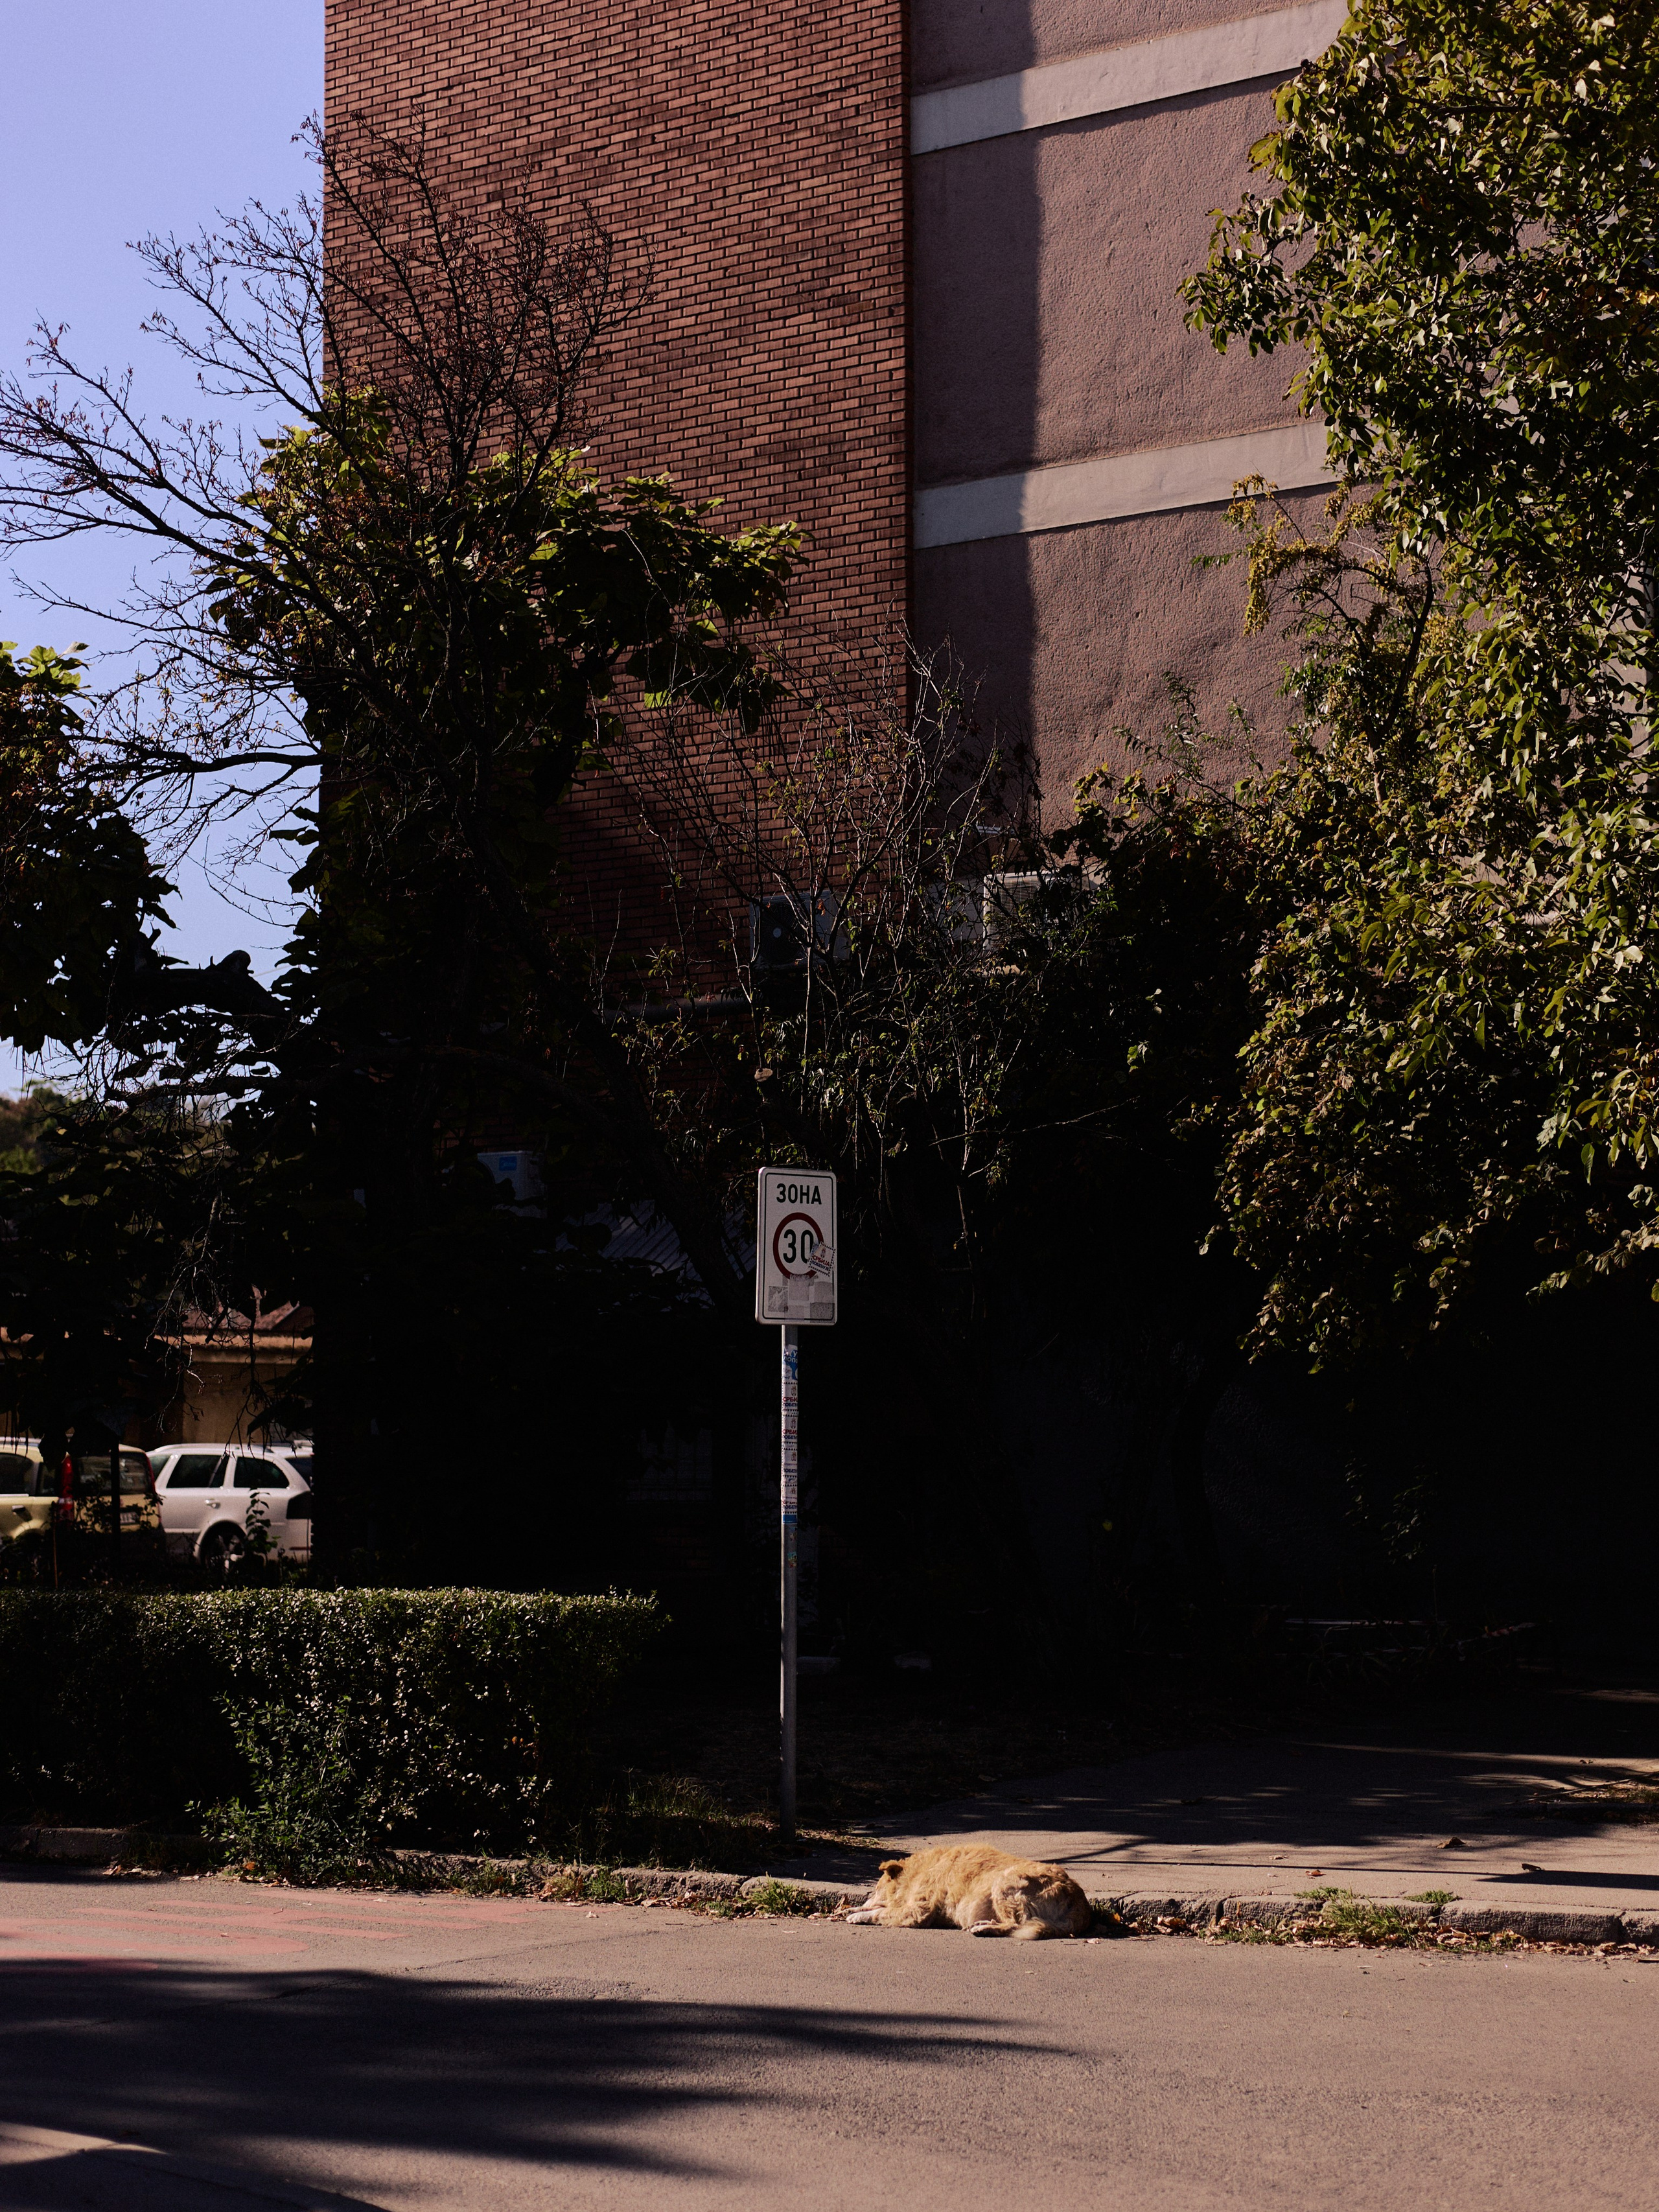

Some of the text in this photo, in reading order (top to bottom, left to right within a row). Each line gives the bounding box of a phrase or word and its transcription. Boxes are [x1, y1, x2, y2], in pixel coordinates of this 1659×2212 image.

[776, 1183, 822, 1205] ЗОНА
[783, 1229, 814, 1264] 30
[813, 1255, 830, 1267] СРБИЈА
